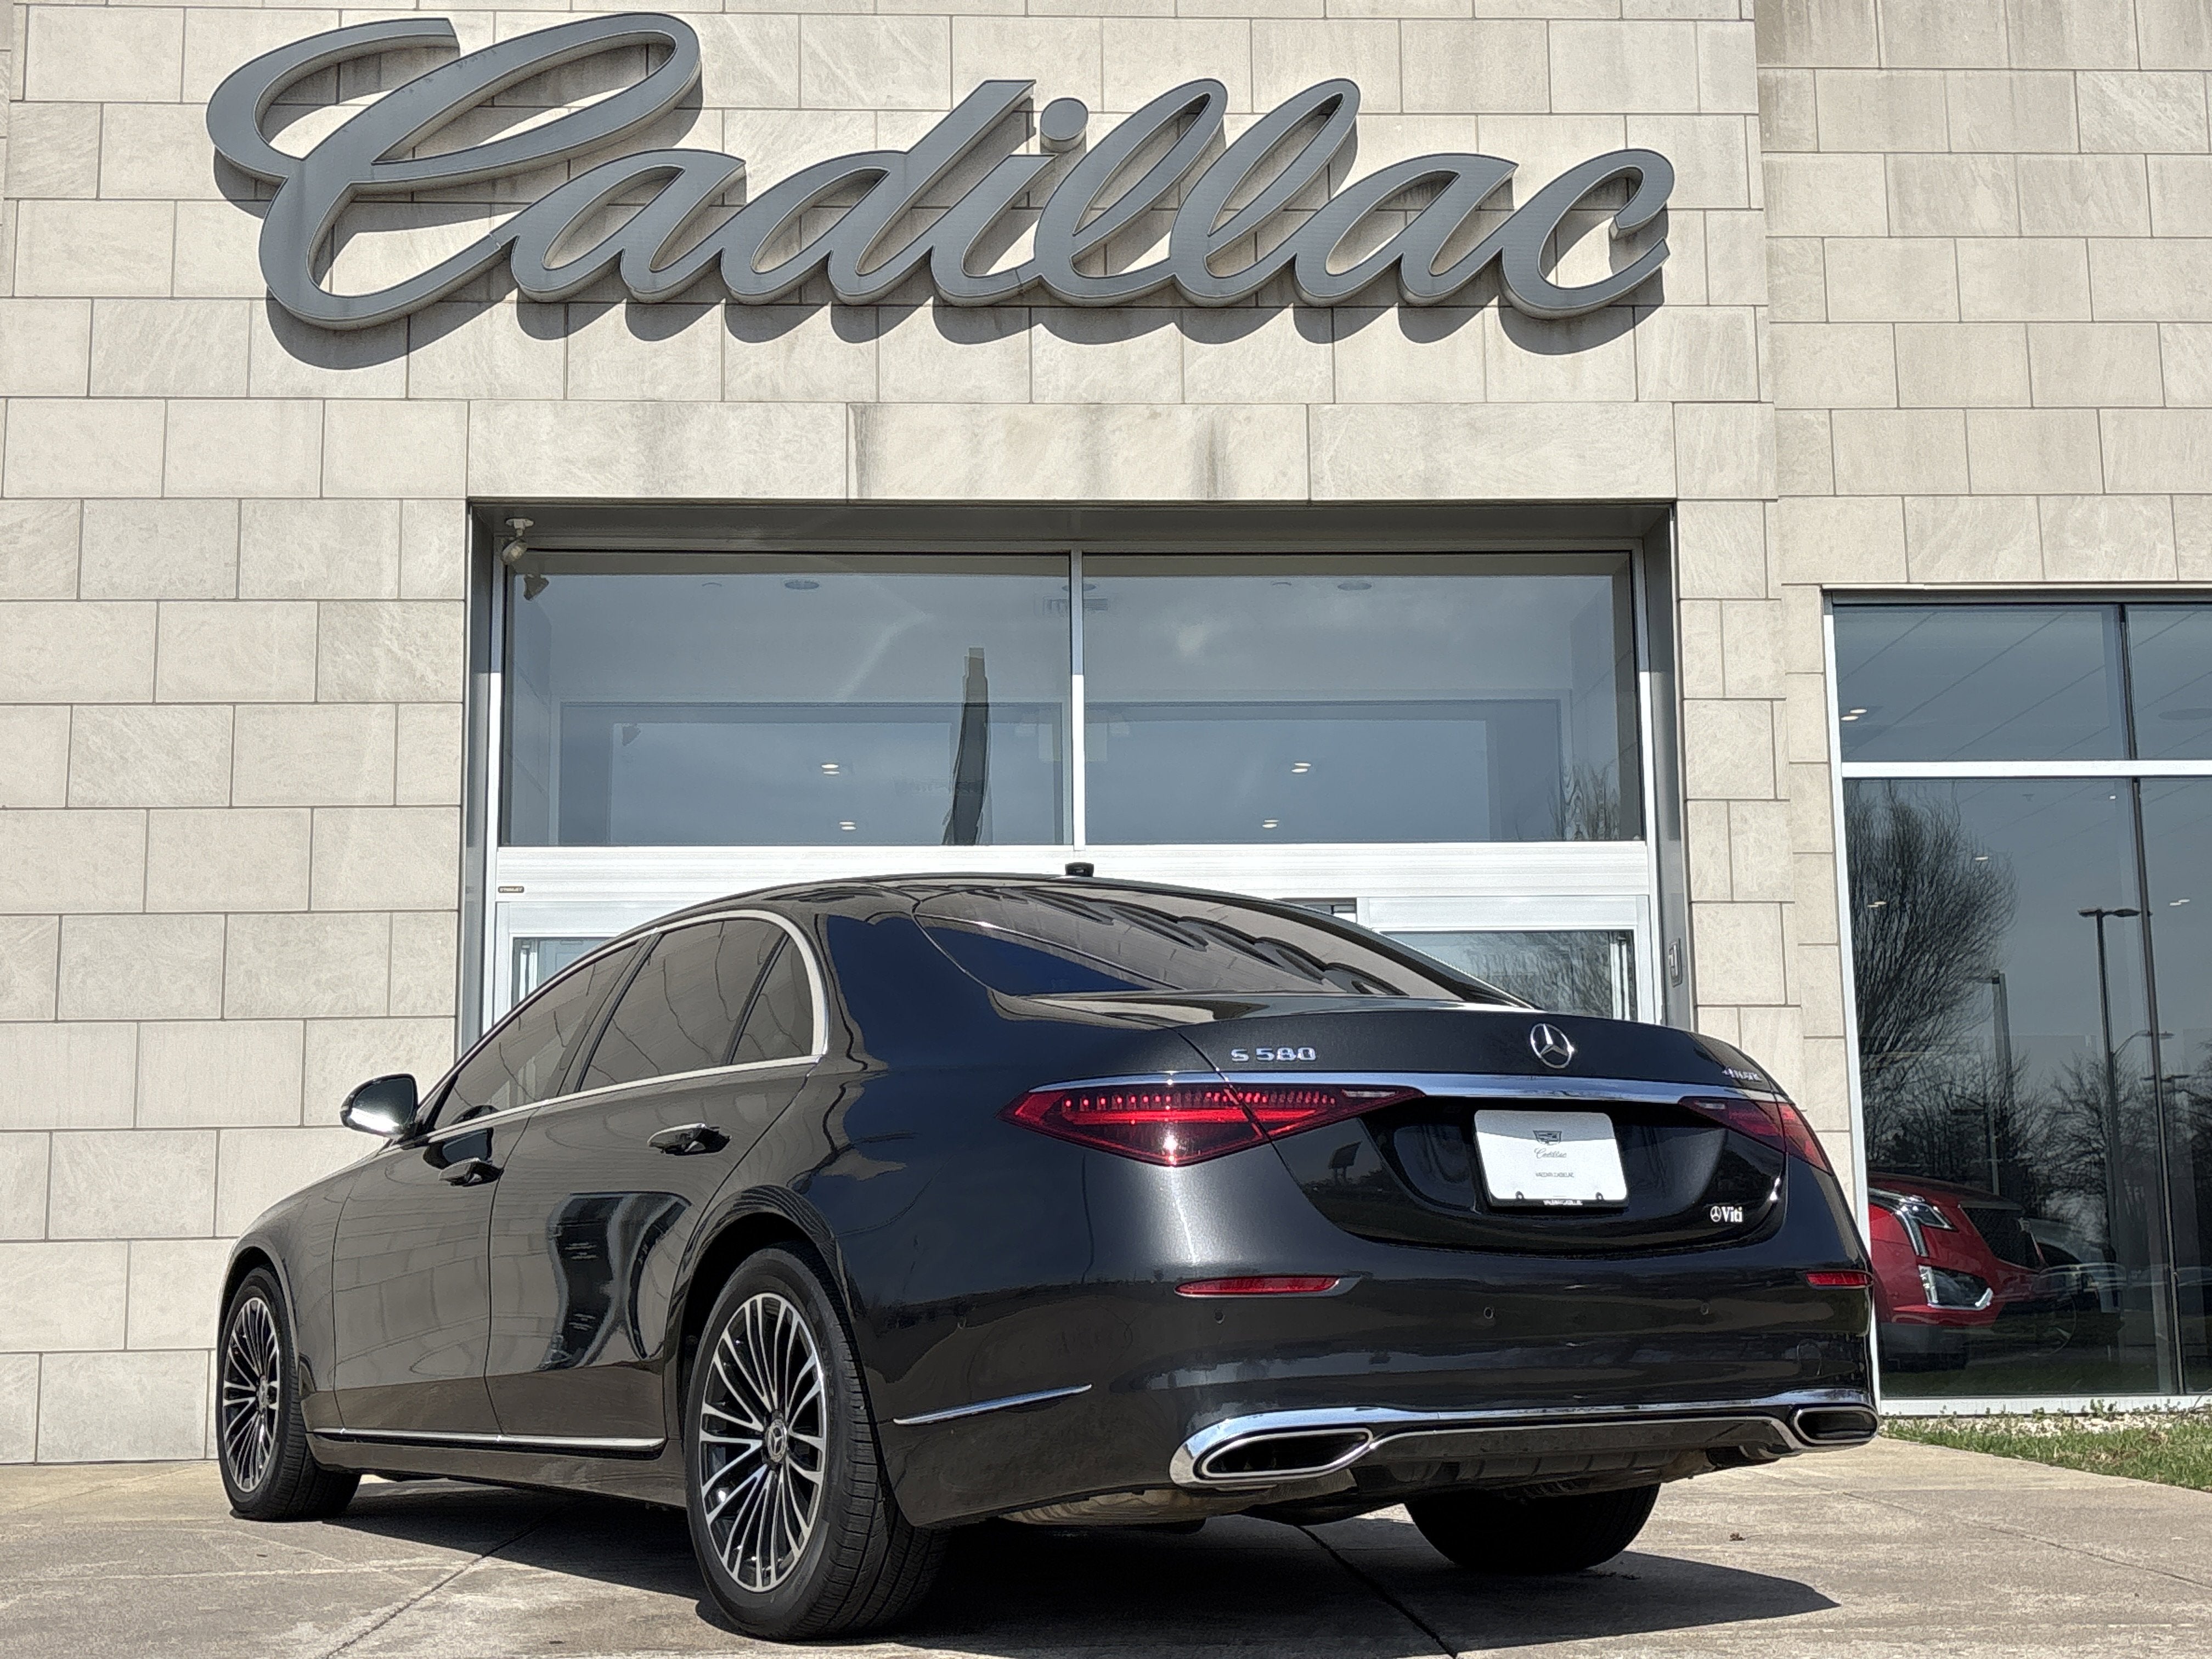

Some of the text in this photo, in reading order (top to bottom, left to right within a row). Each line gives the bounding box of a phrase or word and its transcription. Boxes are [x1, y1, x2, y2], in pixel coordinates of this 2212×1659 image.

[206, 13, 1675, 329] Cadillac
[1231, 1047, 1316, 1062] S 580
[1722, 1206, 1743, 1222] Viti
